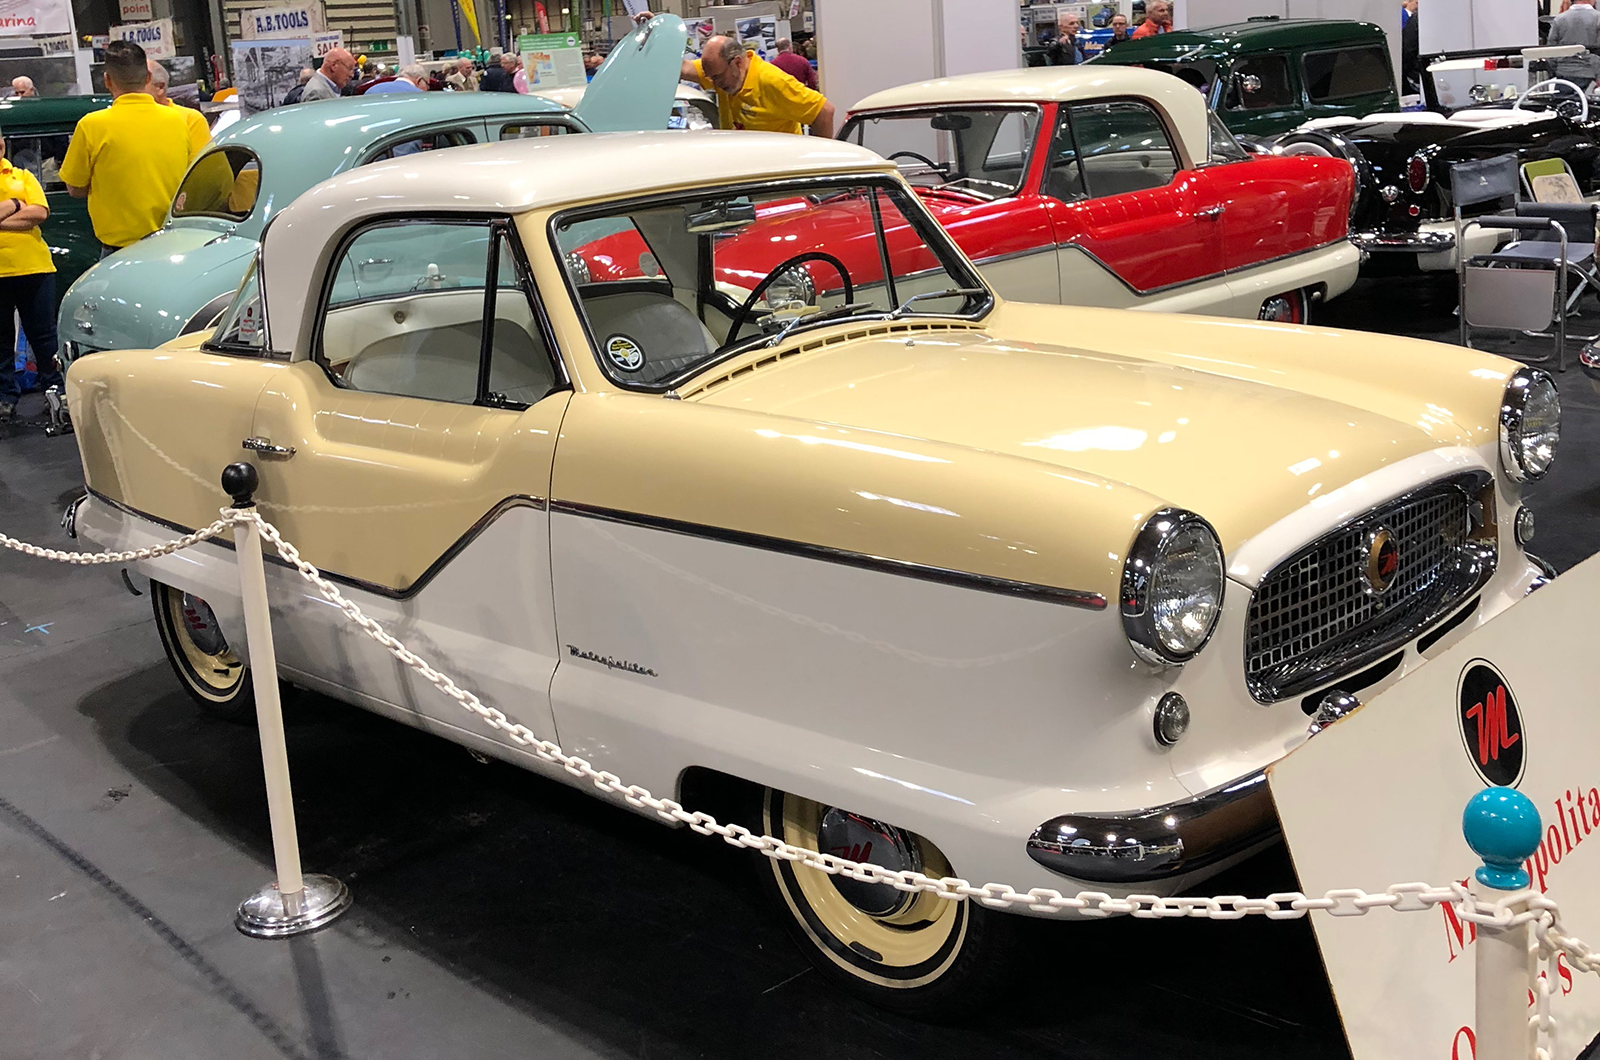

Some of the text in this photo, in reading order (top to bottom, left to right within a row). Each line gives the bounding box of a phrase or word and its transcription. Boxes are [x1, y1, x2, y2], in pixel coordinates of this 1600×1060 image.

[123, 4, 150, 15] point
[256, 10, 309, 33] A.B.TOOLS
[121, 27, 161, 43] AB.TOOLS
